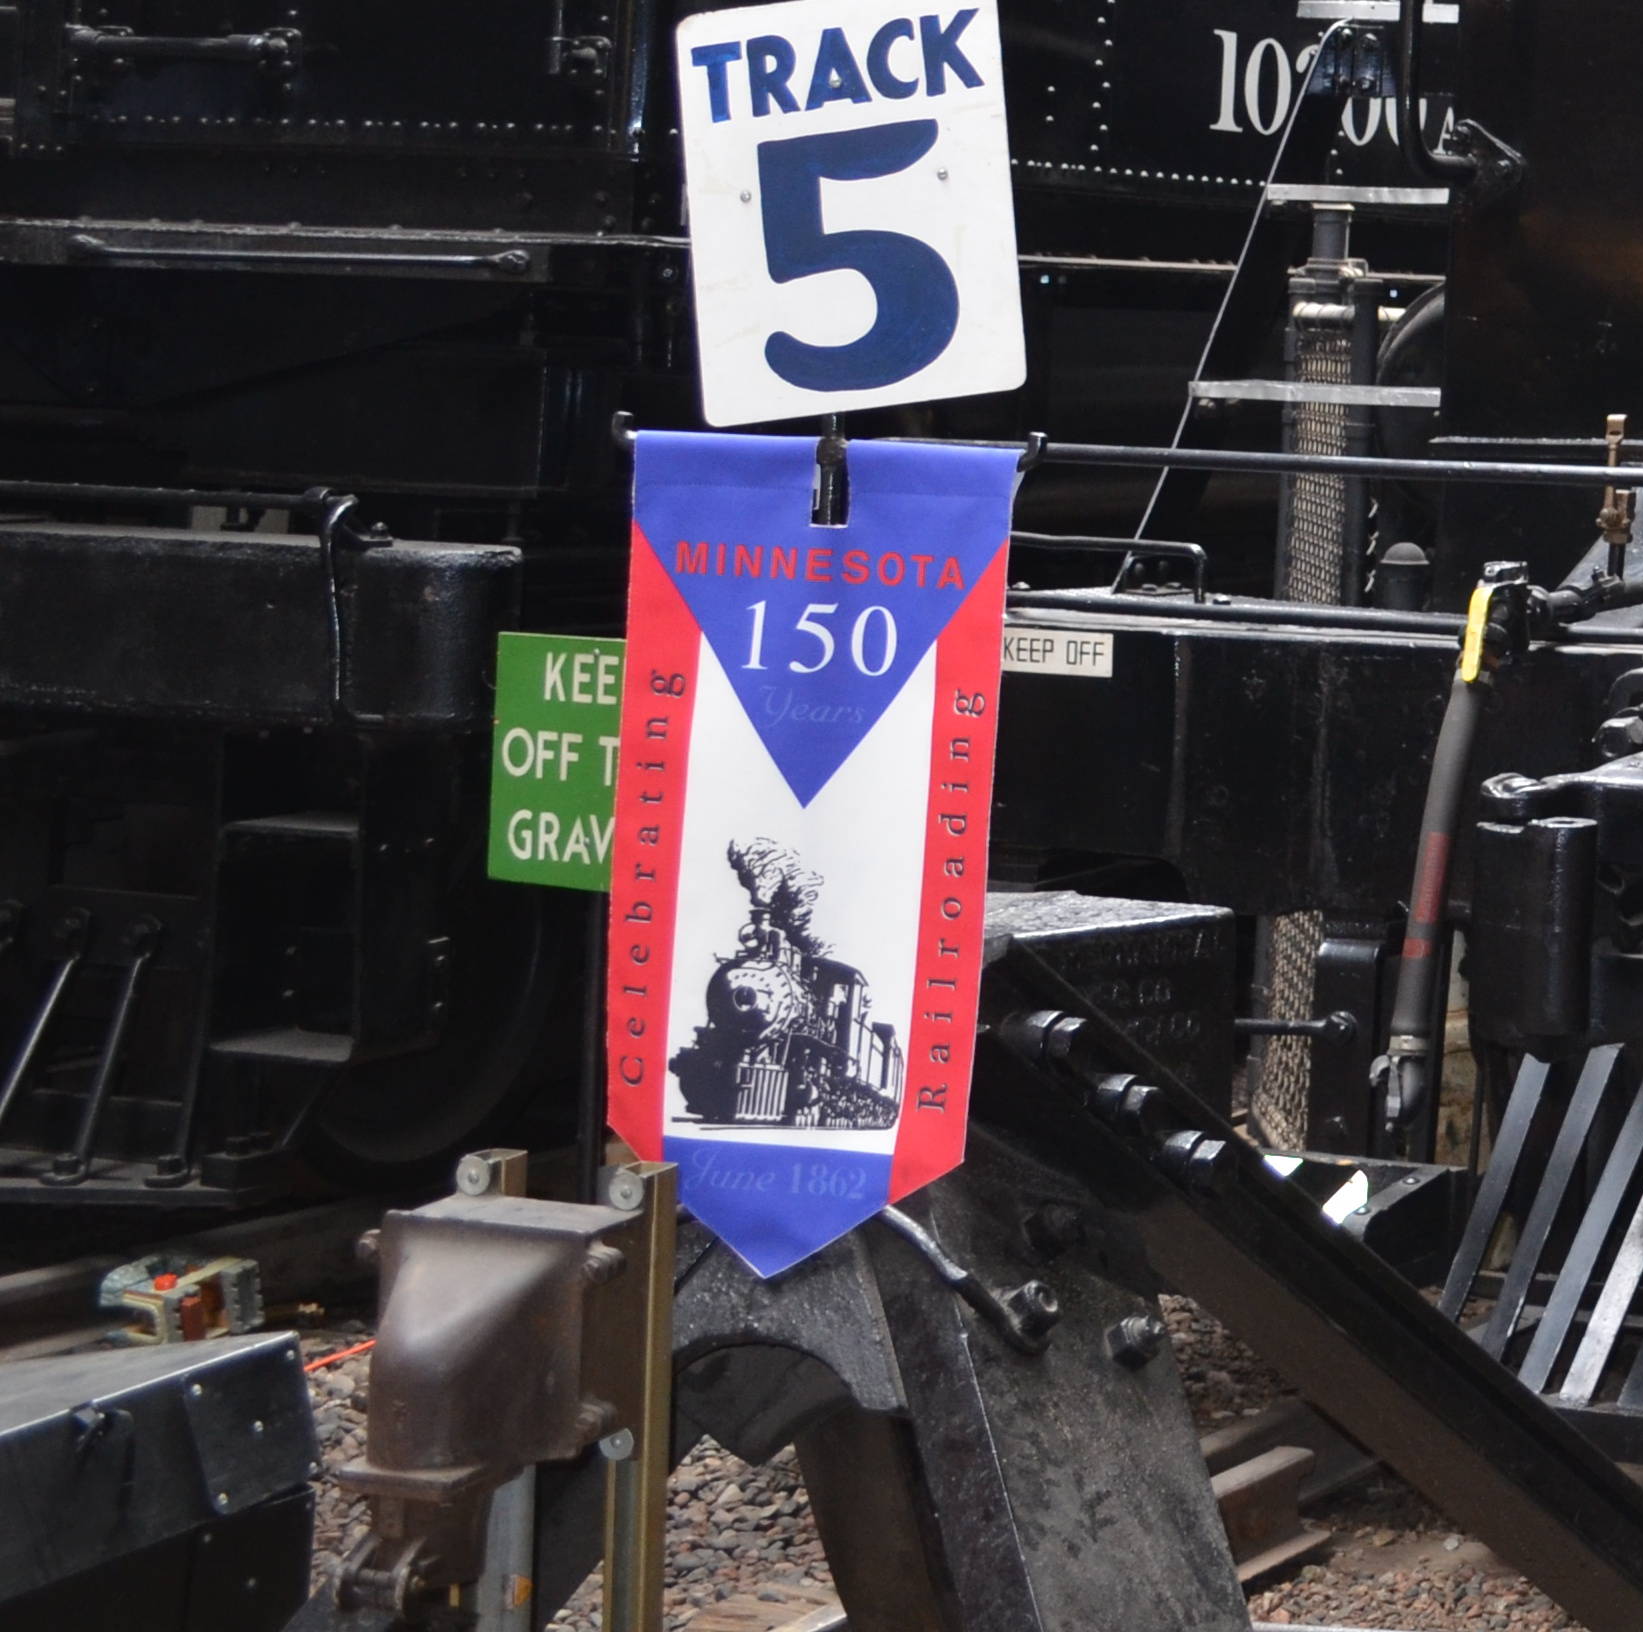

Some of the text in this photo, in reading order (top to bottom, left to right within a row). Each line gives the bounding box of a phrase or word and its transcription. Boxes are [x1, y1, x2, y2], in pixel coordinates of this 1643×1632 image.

[691, 8, 985, 124] TRACK
[757, 118, 960, 393] 5
[673, 540, 967, 592] MINNESOTA
[740, 601, 900, 680] 150
[1003, 637, 1105, 666] KEEP OFF
[544, 651, 620, 706] KEE
[760, 683, 868, 729] Years
[502, 727, 583, 782] OFF
[507, 808, 616, 865] GRAV
[617, 667, 687, 1087] Celebrating
[915, 688, 987, 1116] Railroading
[682, 1147, 869, 1200] June 1862
